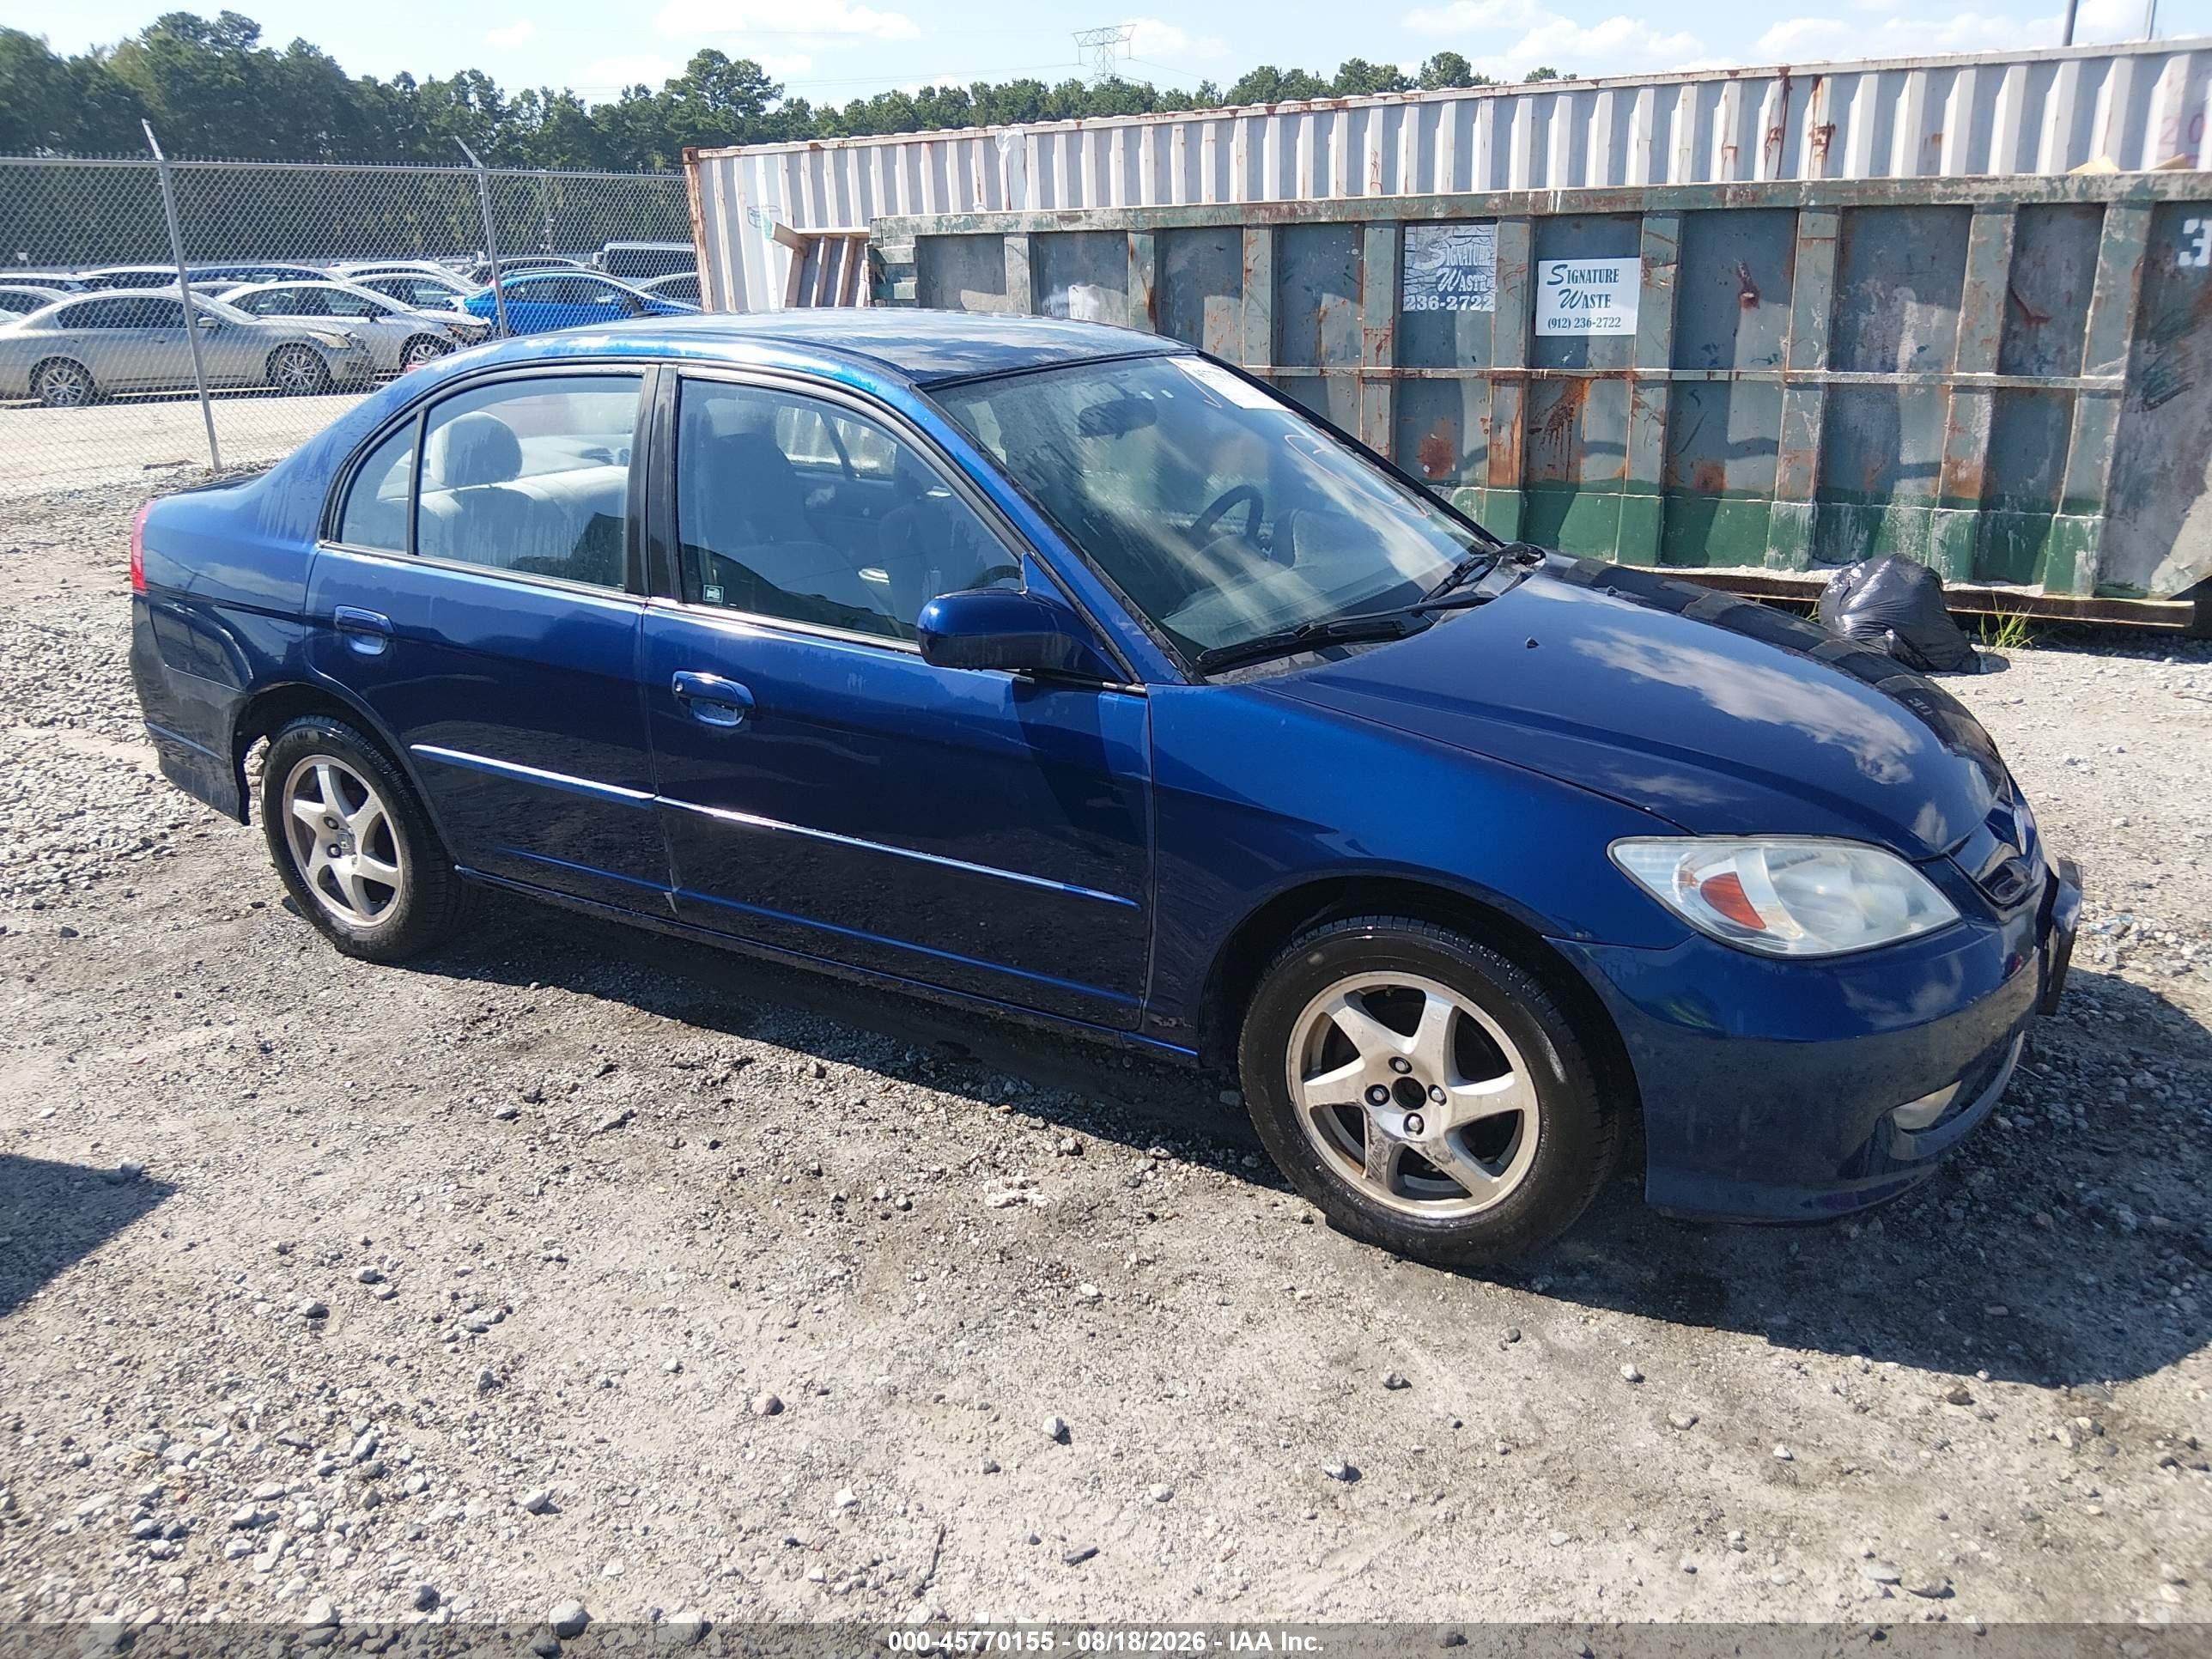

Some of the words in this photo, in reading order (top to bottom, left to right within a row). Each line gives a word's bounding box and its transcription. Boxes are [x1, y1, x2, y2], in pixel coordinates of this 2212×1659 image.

[1547, 264, 1620, 286] SIGNATURE
[1559, 289, 1611, 309] WASTE
[1547, 317, 1571, 330] (912)
[1574, 317, 1621, 329] 236-2722
